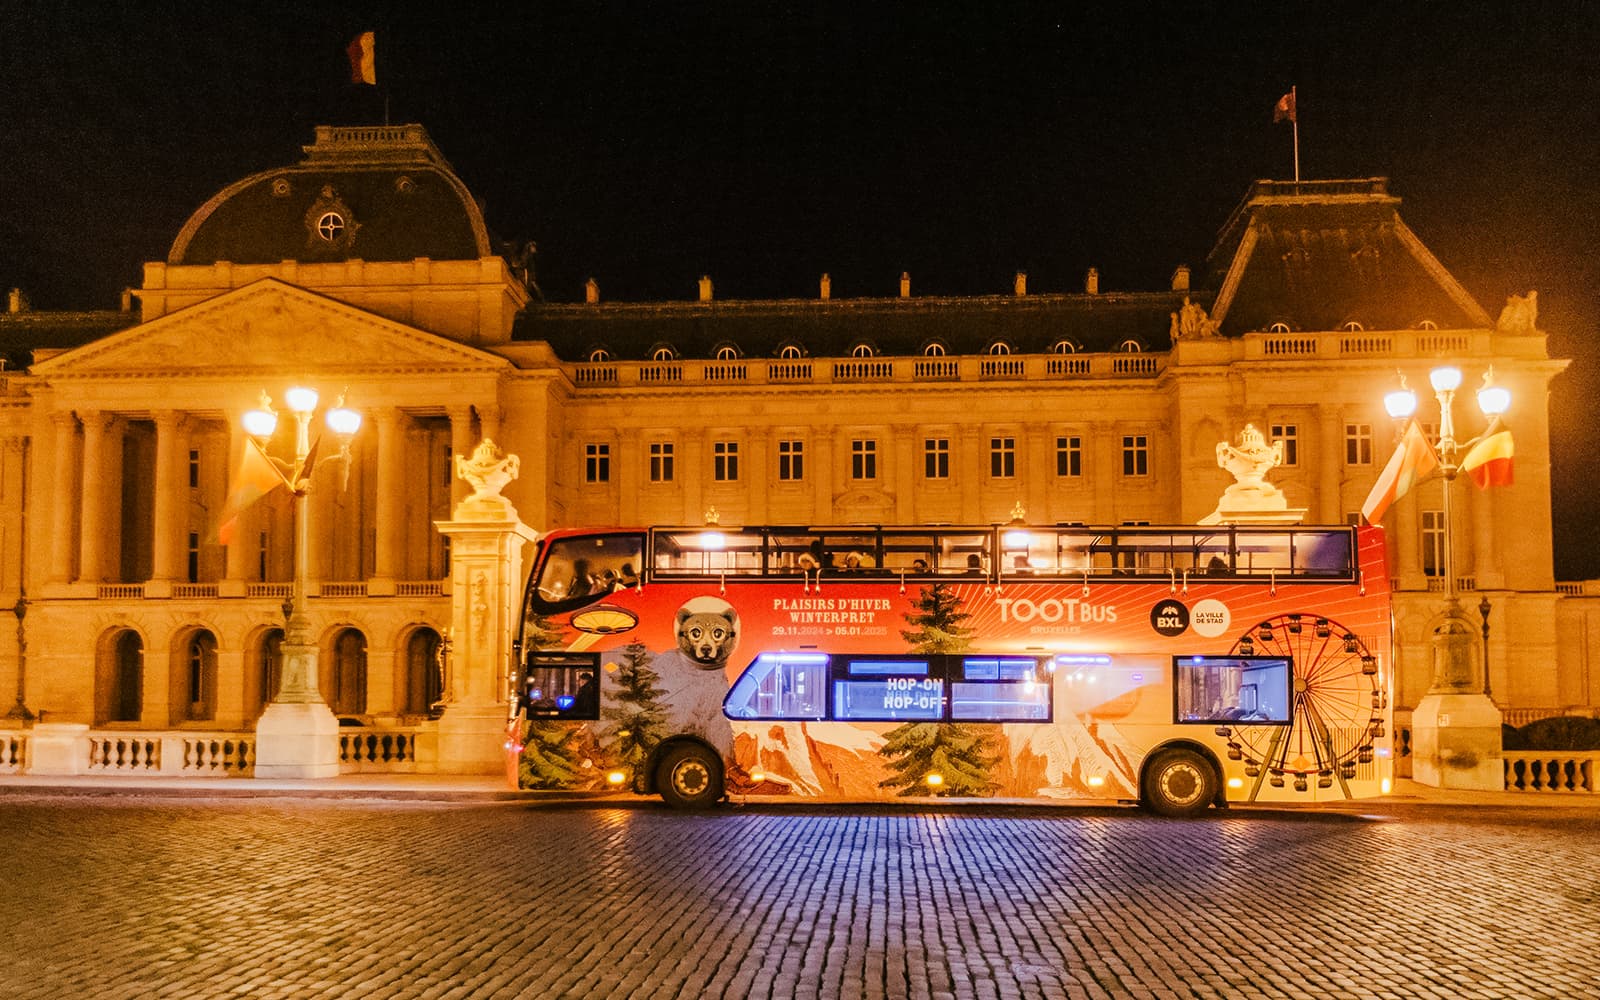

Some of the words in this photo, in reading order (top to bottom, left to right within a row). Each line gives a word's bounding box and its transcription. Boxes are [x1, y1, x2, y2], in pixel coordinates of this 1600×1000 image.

[773, 599, 835, 610] PLAISIRS
[838, 599, 891, 610] D'HIVER
[790, 611, 875, 623] WINTERPRET
[1157, 617, 1184, 628] BXL
[772, 626, 824, 635] 29.11.2024
[834, 626, 888, 635] 05.01.2025
[887, 678, 943, 691] HOP-ON
[884, 696, 948, 709] HOP-OFF
